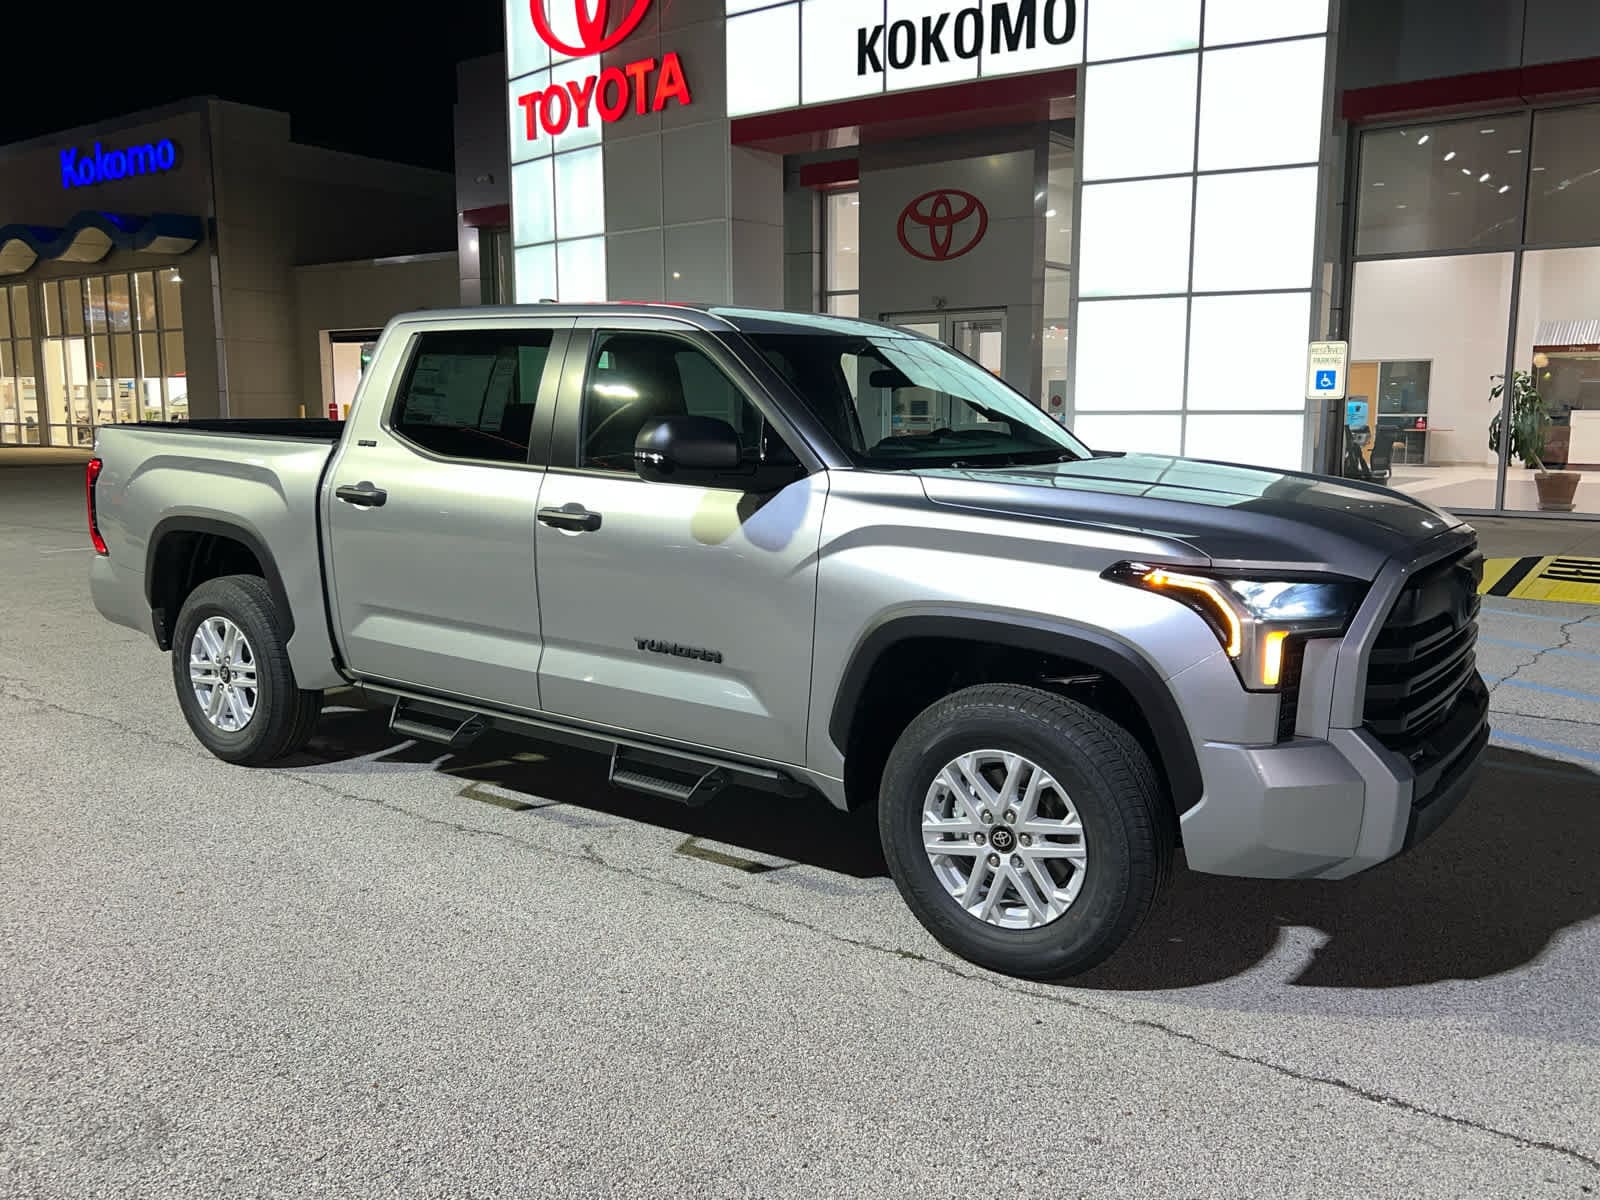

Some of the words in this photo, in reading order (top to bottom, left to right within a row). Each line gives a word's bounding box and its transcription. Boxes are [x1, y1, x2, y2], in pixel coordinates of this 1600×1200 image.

[857, 0, 1076, 75] KOKOMO
[518, 52, 691, 140] TOYOTA
[60, 138, 175, 188] Kokomo
[634, 636, 722, 664] TUNDRA
